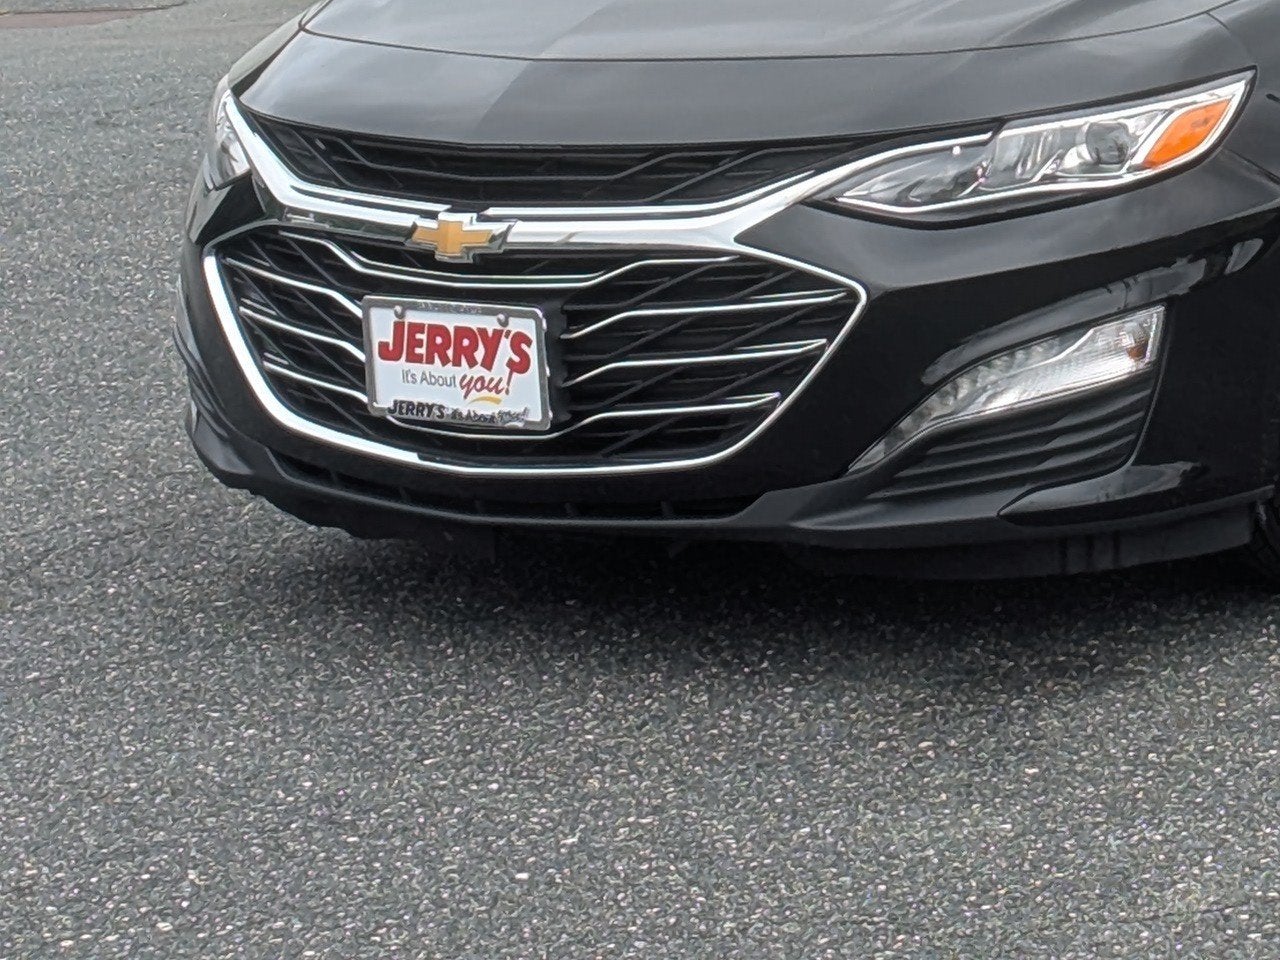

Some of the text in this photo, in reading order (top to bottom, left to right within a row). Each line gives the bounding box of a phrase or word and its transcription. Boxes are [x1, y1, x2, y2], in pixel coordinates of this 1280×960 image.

[378, 321, 533, 374] JERRY'S
[401, 369, 513, 400] It's About you!
